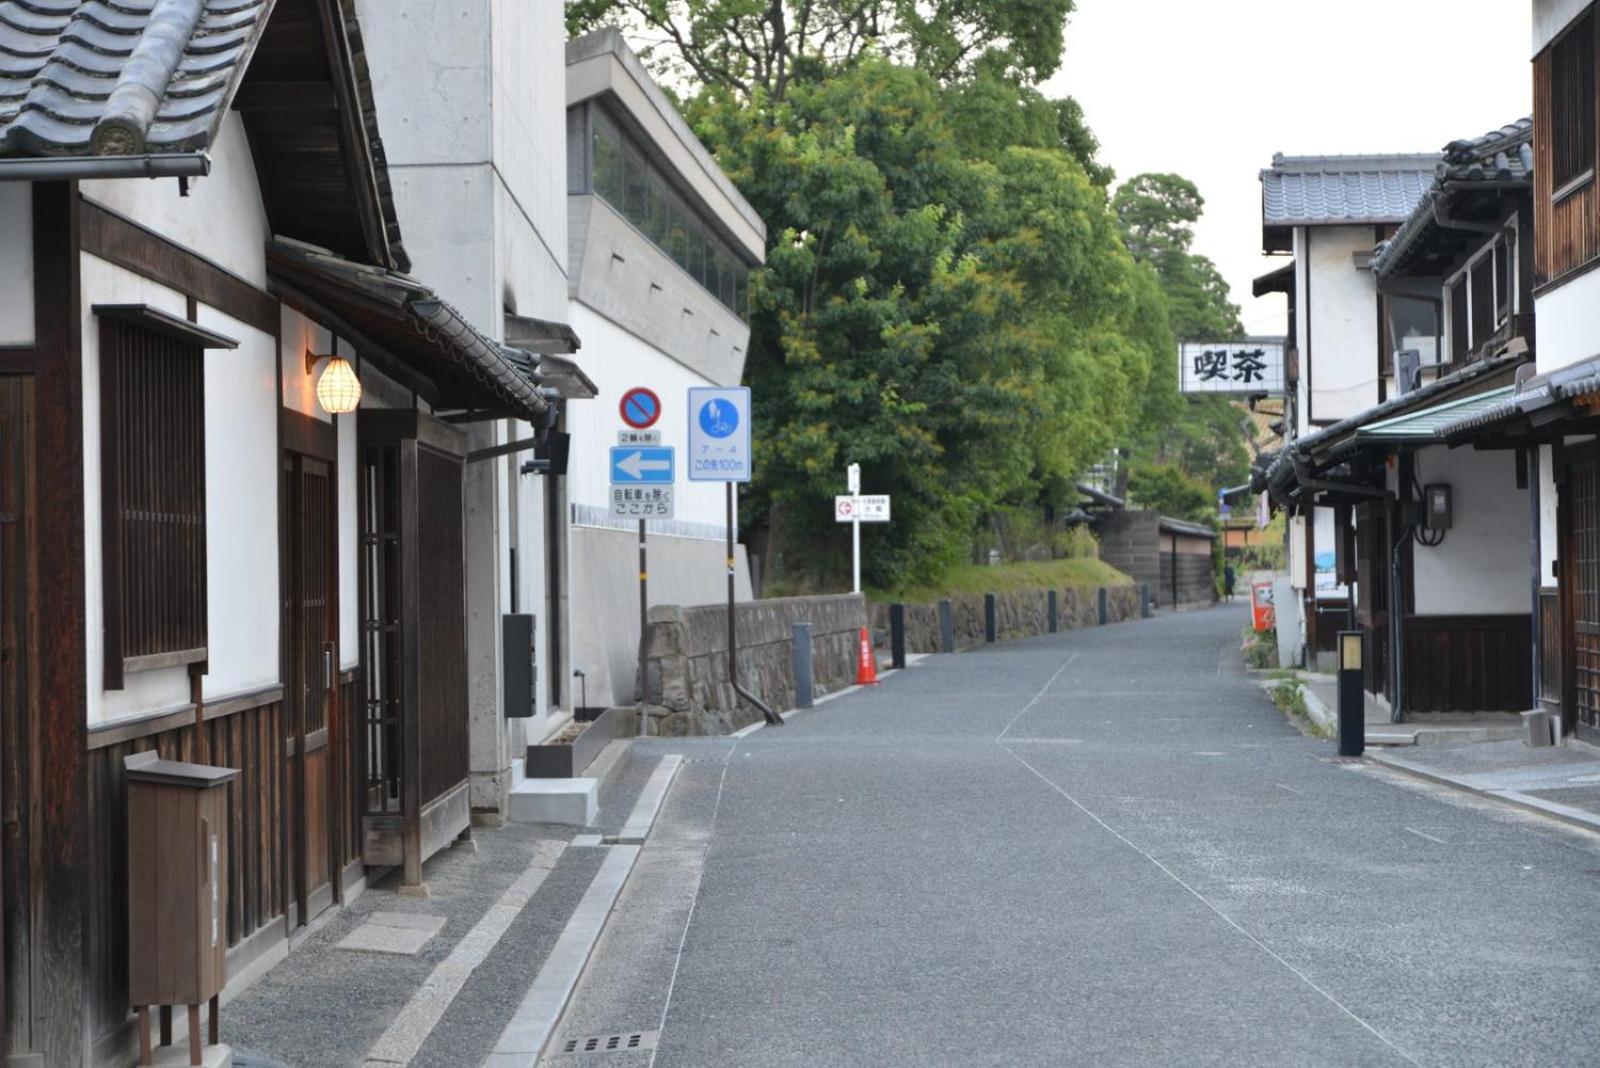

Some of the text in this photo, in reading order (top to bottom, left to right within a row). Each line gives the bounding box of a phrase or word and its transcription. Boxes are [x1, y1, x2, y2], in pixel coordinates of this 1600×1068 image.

[1194, 349, 1268, 383] 喫茶
[615, 503, 668, 514] ここから
